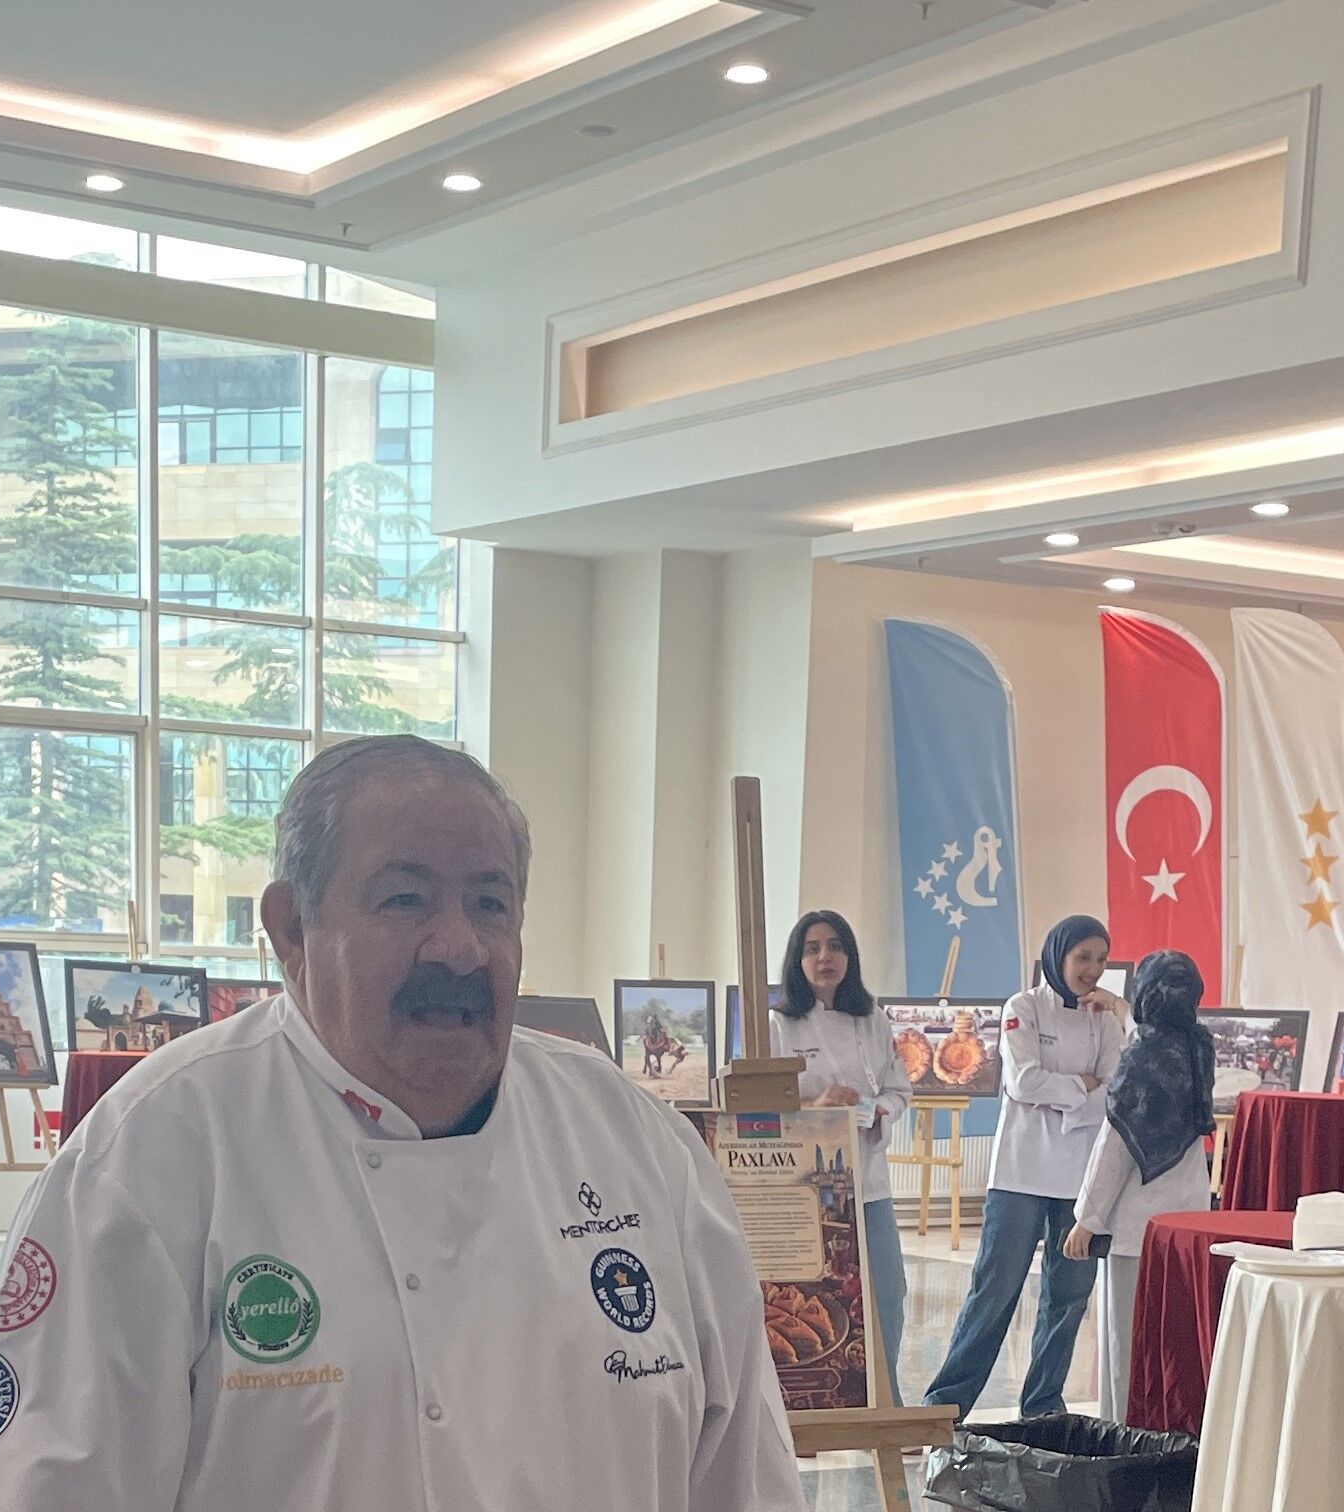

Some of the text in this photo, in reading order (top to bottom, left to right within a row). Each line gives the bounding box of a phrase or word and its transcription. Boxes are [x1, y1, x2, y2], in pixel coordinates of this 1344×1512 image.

[728, 1150, 796, 1168] PAXLAVA
[595, 1251, 642, 1279] GUINNESS
[597, 1281, 653, 1329] WORLD RECORDS
